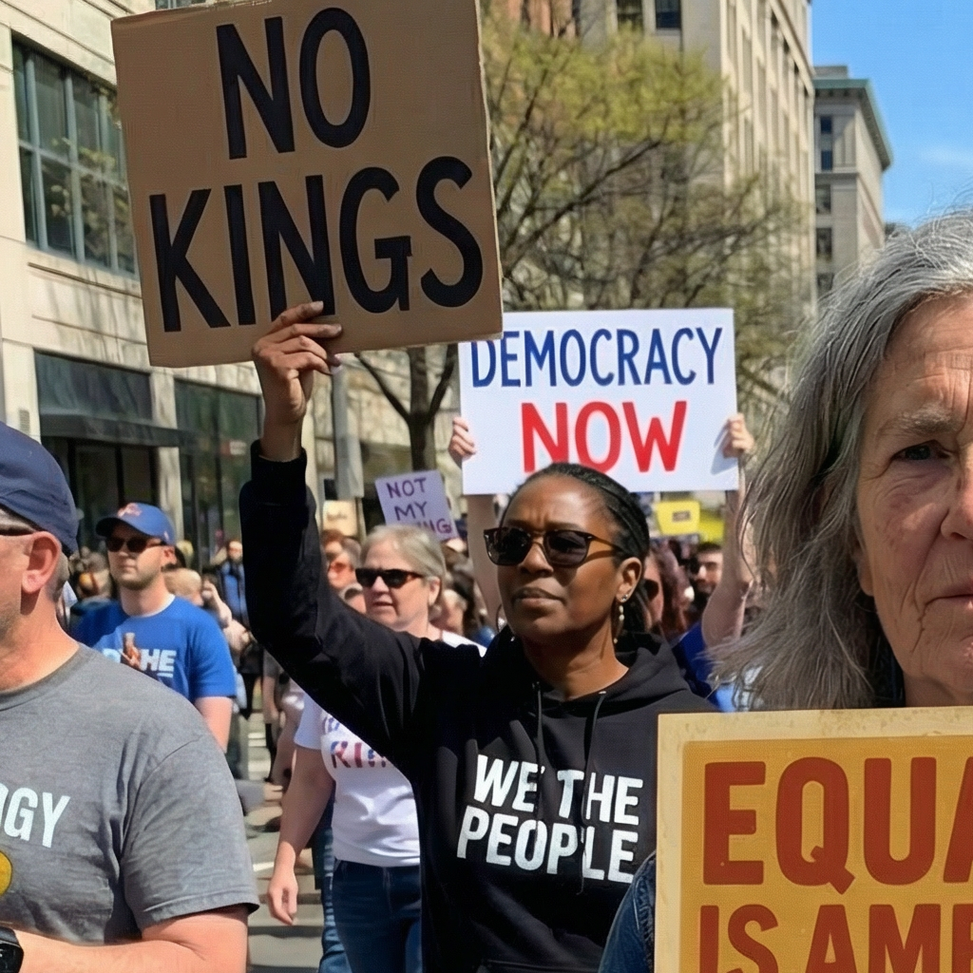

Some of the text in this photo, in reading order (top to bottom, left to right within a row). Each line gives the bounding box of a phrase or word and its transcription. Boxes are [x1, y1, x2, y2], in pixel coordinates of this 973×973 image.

[216, 7, 371, 159] NO
[149, 156, 484, 332] KINGS
[471, 327, 723, 388] DEMOCRACY
[521, 400, 687, 473] NOW
[386, 477, 427, 498] NOT
[394, 501, 427, 520] MY
[557, 769, 644, 826] THE
[456, 805, 639, 884] PEOPLE
